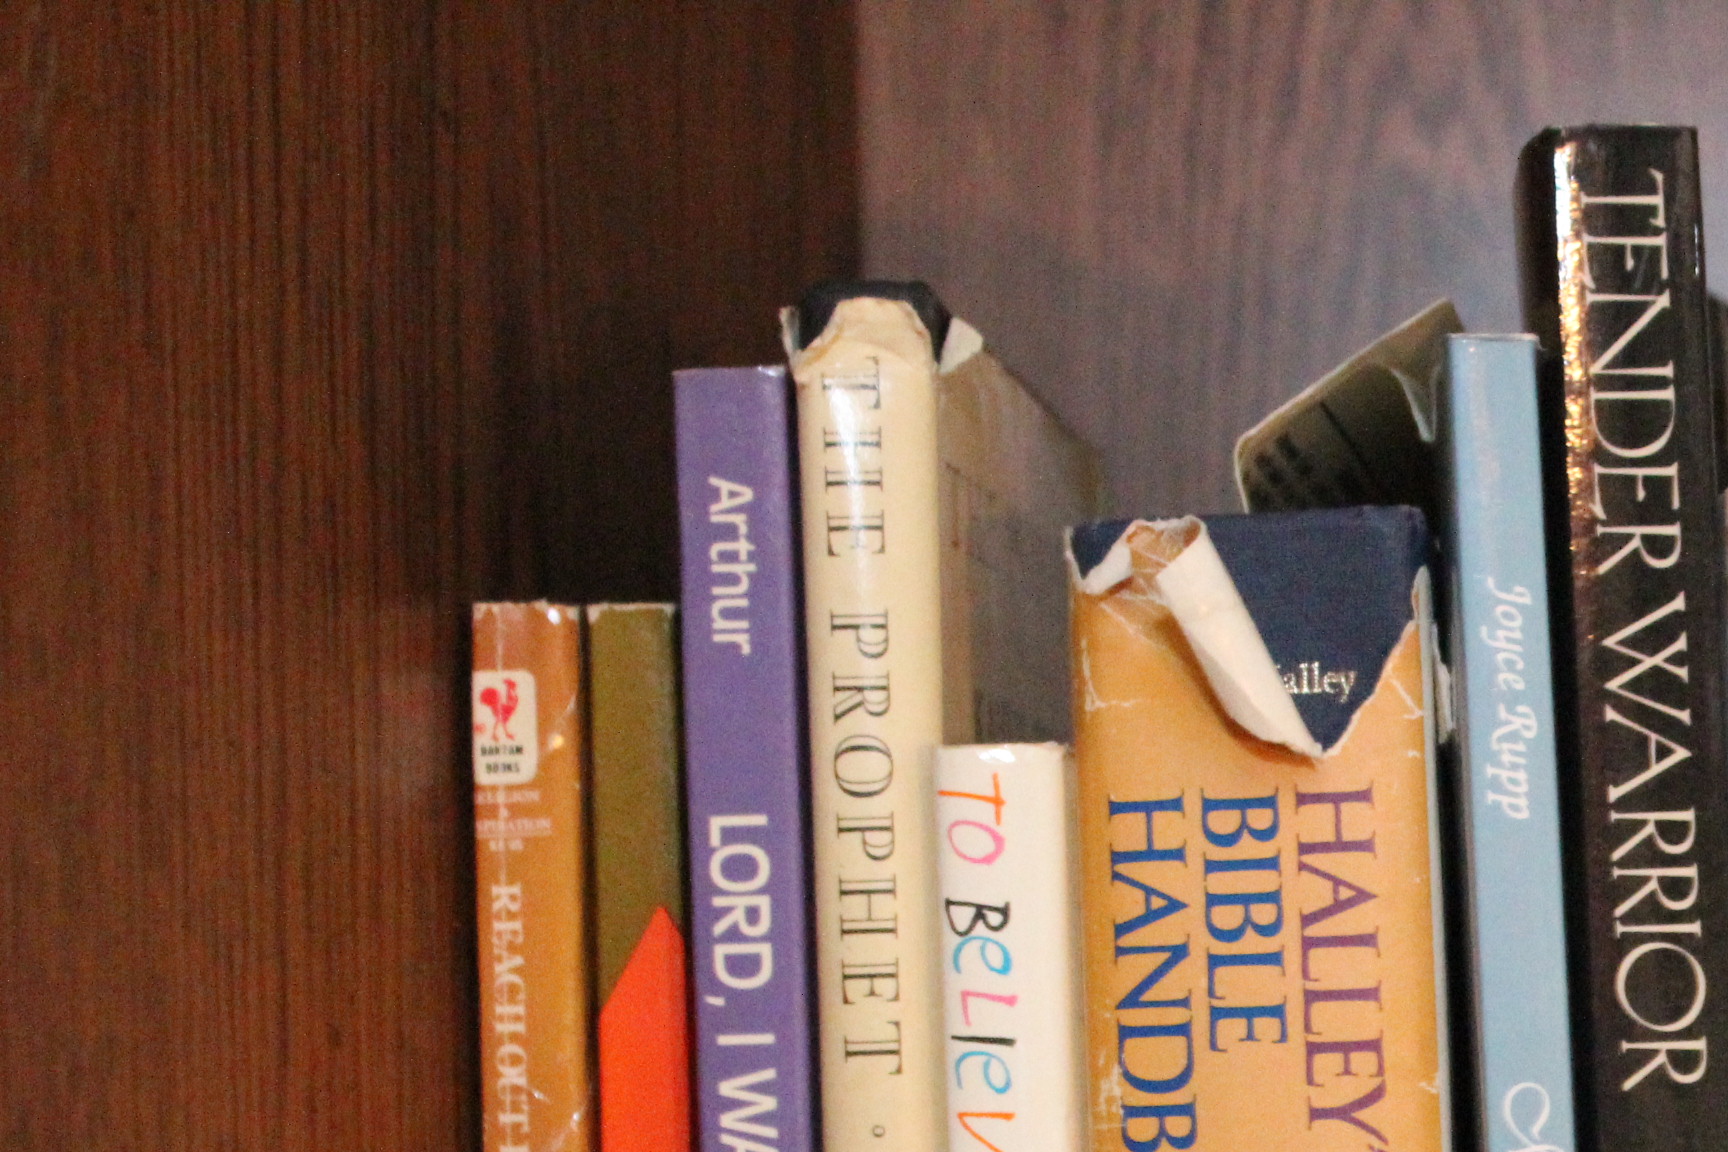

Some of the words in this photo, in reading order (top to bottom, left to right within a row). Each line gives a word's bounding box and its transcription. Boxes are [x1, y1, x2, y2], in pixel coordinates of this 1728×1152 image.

[1579, 167, 1682, 577] TENDER
[821, 355, 886, 558] THE
[708, 476, 758, 655] Arthur
[1479, 577, 1536, 692] Joyce
[1277, 660, 1359, 704] alley
[1486, 704, 1538, 820] Rupp
[485, 762, 520, 774] BOOKS
[830, 608, 903, 1076] PROPHET
[938, 773, 1006, 866] TO
[1599, 590, 1709, 1092] WARRIOR
[491, 884, 526, 1047] REACH
[704, 813, 773, 1007] LORD,
[1200, 786, 1289, 1053] BIBLE
[497, 1043, 531, 1131] OUT
[716, 1032, 776, 1047] I
